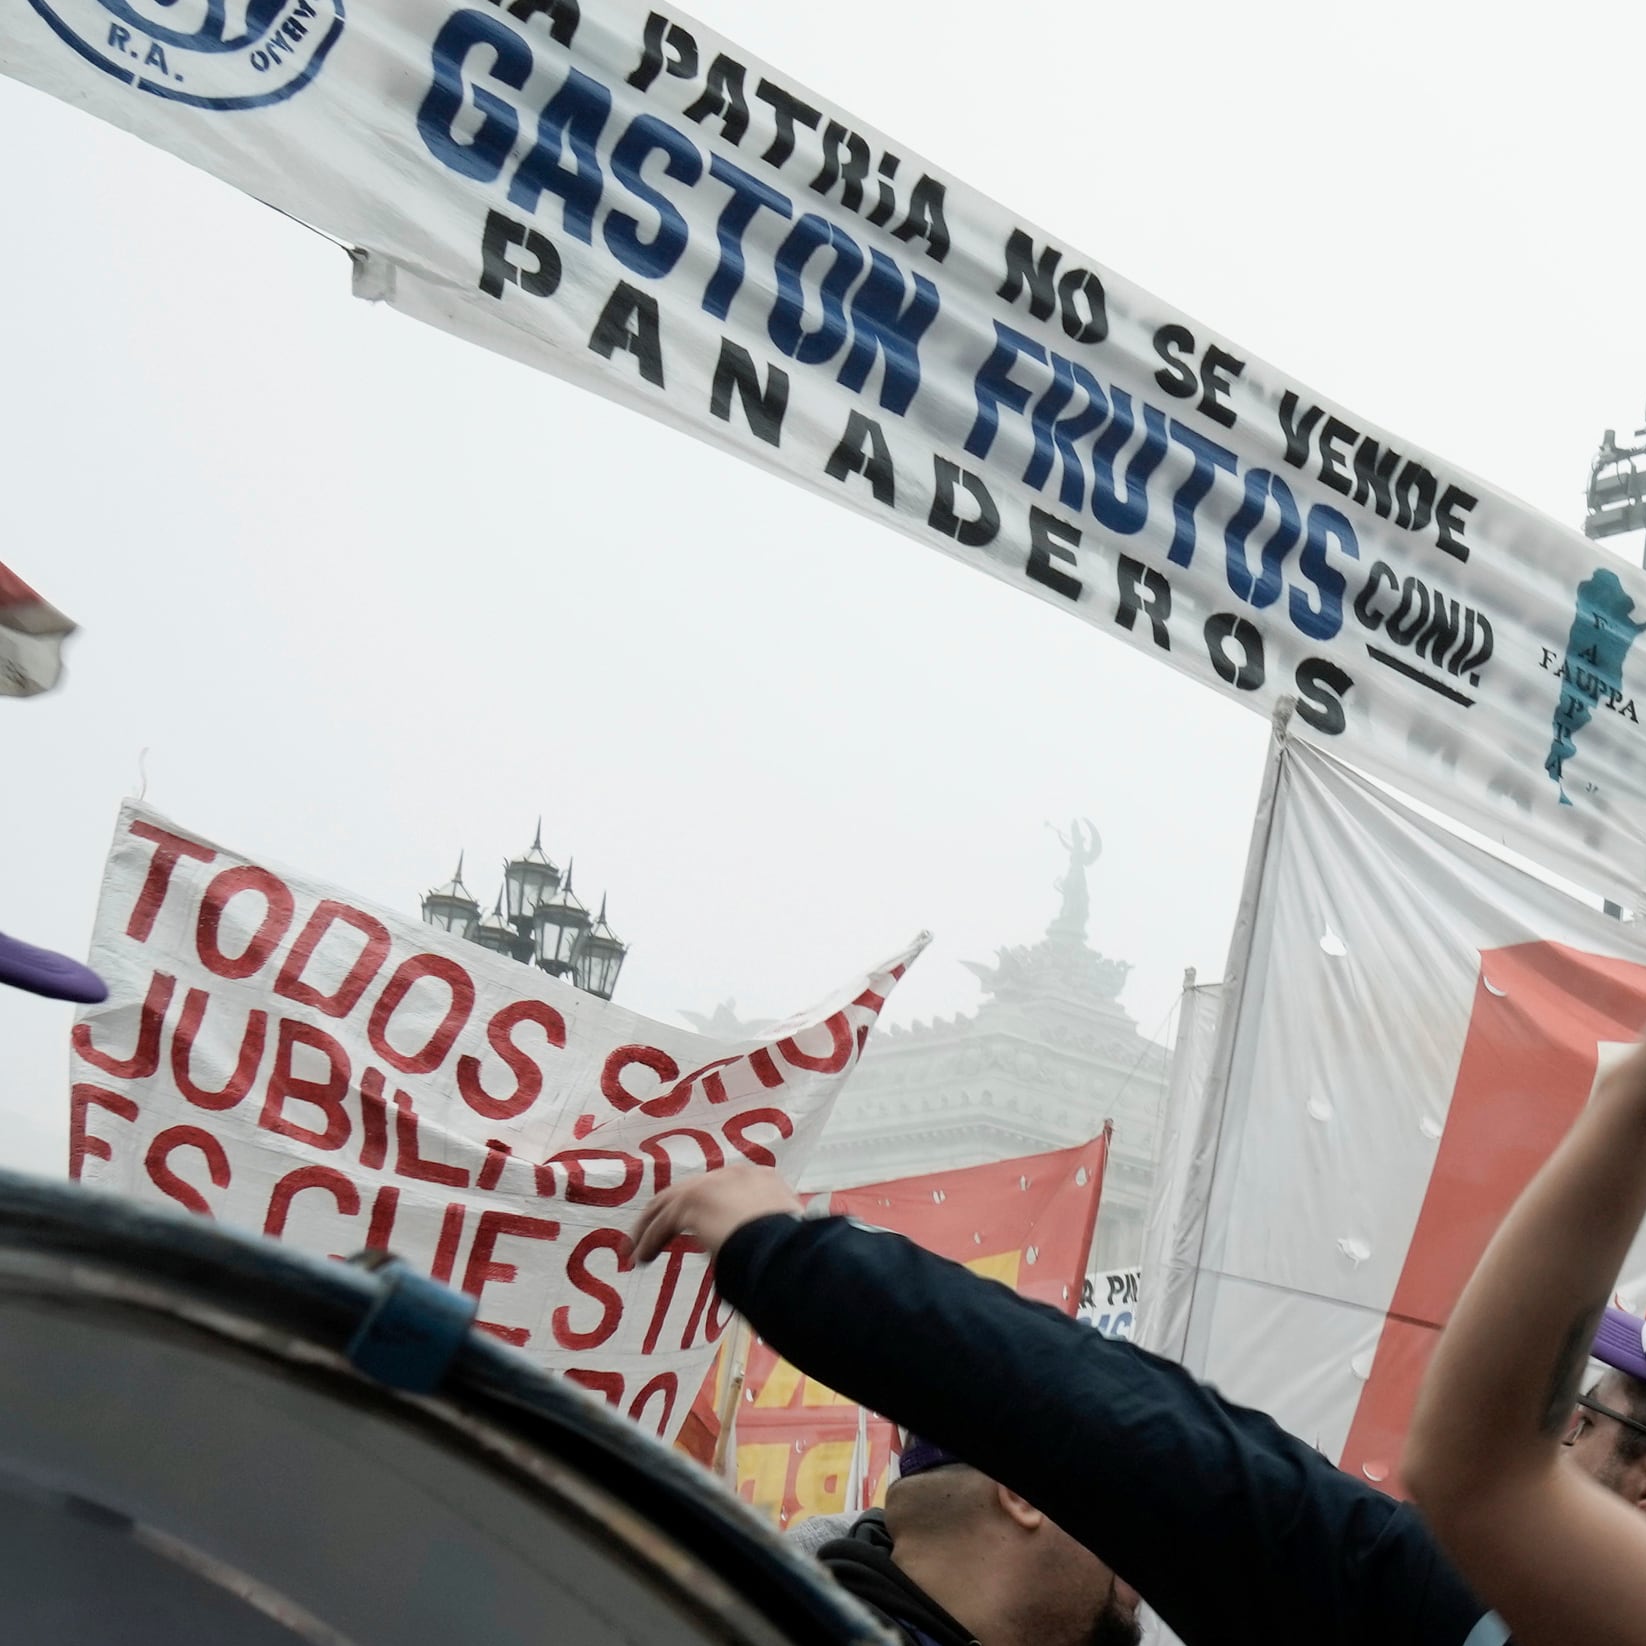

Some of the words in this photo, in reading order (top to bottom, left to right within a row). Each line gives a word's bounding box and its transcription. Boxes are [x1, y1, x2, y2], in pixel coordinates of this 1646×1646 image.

[107, 22, 184, 83] R.A.
[417, 8, 941, 417] GASTON
[963, 318, 1360, 642] FRUTOS
[478, 208, 1356, 735] PANADEROS
[488, 0, 581, 49] A
[995, 228, 1109, 345] NO
[1152, 323, 1246, 429] SE
[1278, 389, 1479, 563] VENDE
[1539, 647, 1639, 724] FAUPPA
[124, 820, 566, 1120] TODOS
